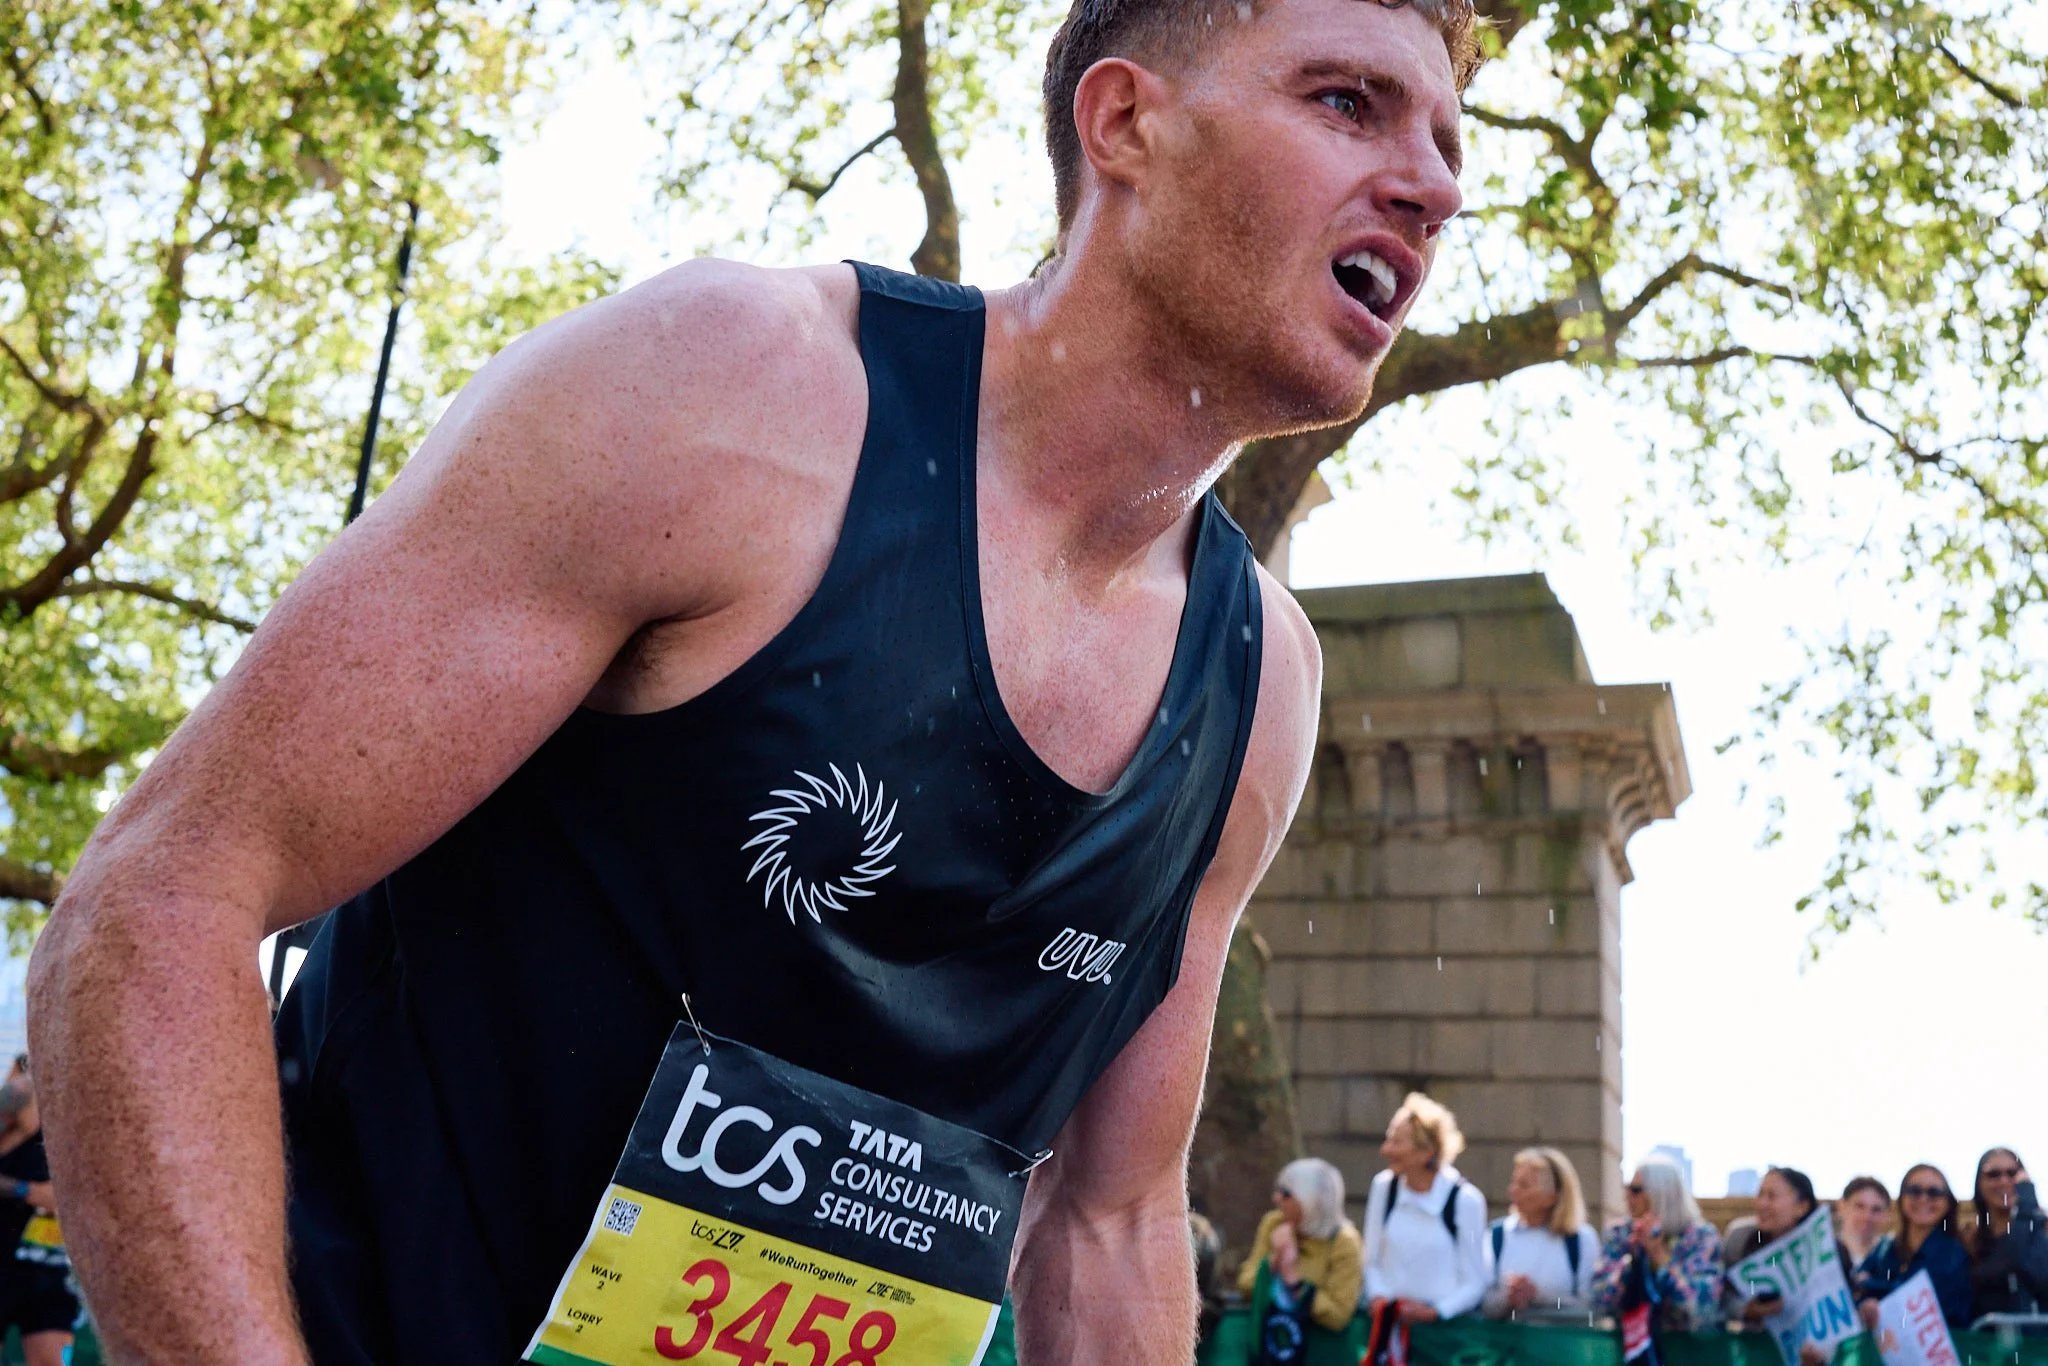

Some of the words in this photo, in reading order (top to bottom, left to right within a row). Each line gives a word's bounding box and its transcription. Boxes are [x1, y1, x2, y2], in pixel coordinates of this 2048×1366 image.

[661, 1063, 822, 1206] tcs
[848, 1119, 923, 1173] TATA
[813, 1191, 937, 1253] SERVICES
[830, 1157, 1001, 1236] CONSULTANCY
[591, 1264, 623, 1283] WAVE
[597, 1280, 605, 1290] 2
[760, 1248, 858, 1287] #WeRunTogether
[567, 1307, 603, 1326] LORRY
[575, 1324, 583, 1333] 2
[654, 1258, 897, 1366] 3458
[1905, 1287, 1960, 1366] STEV
